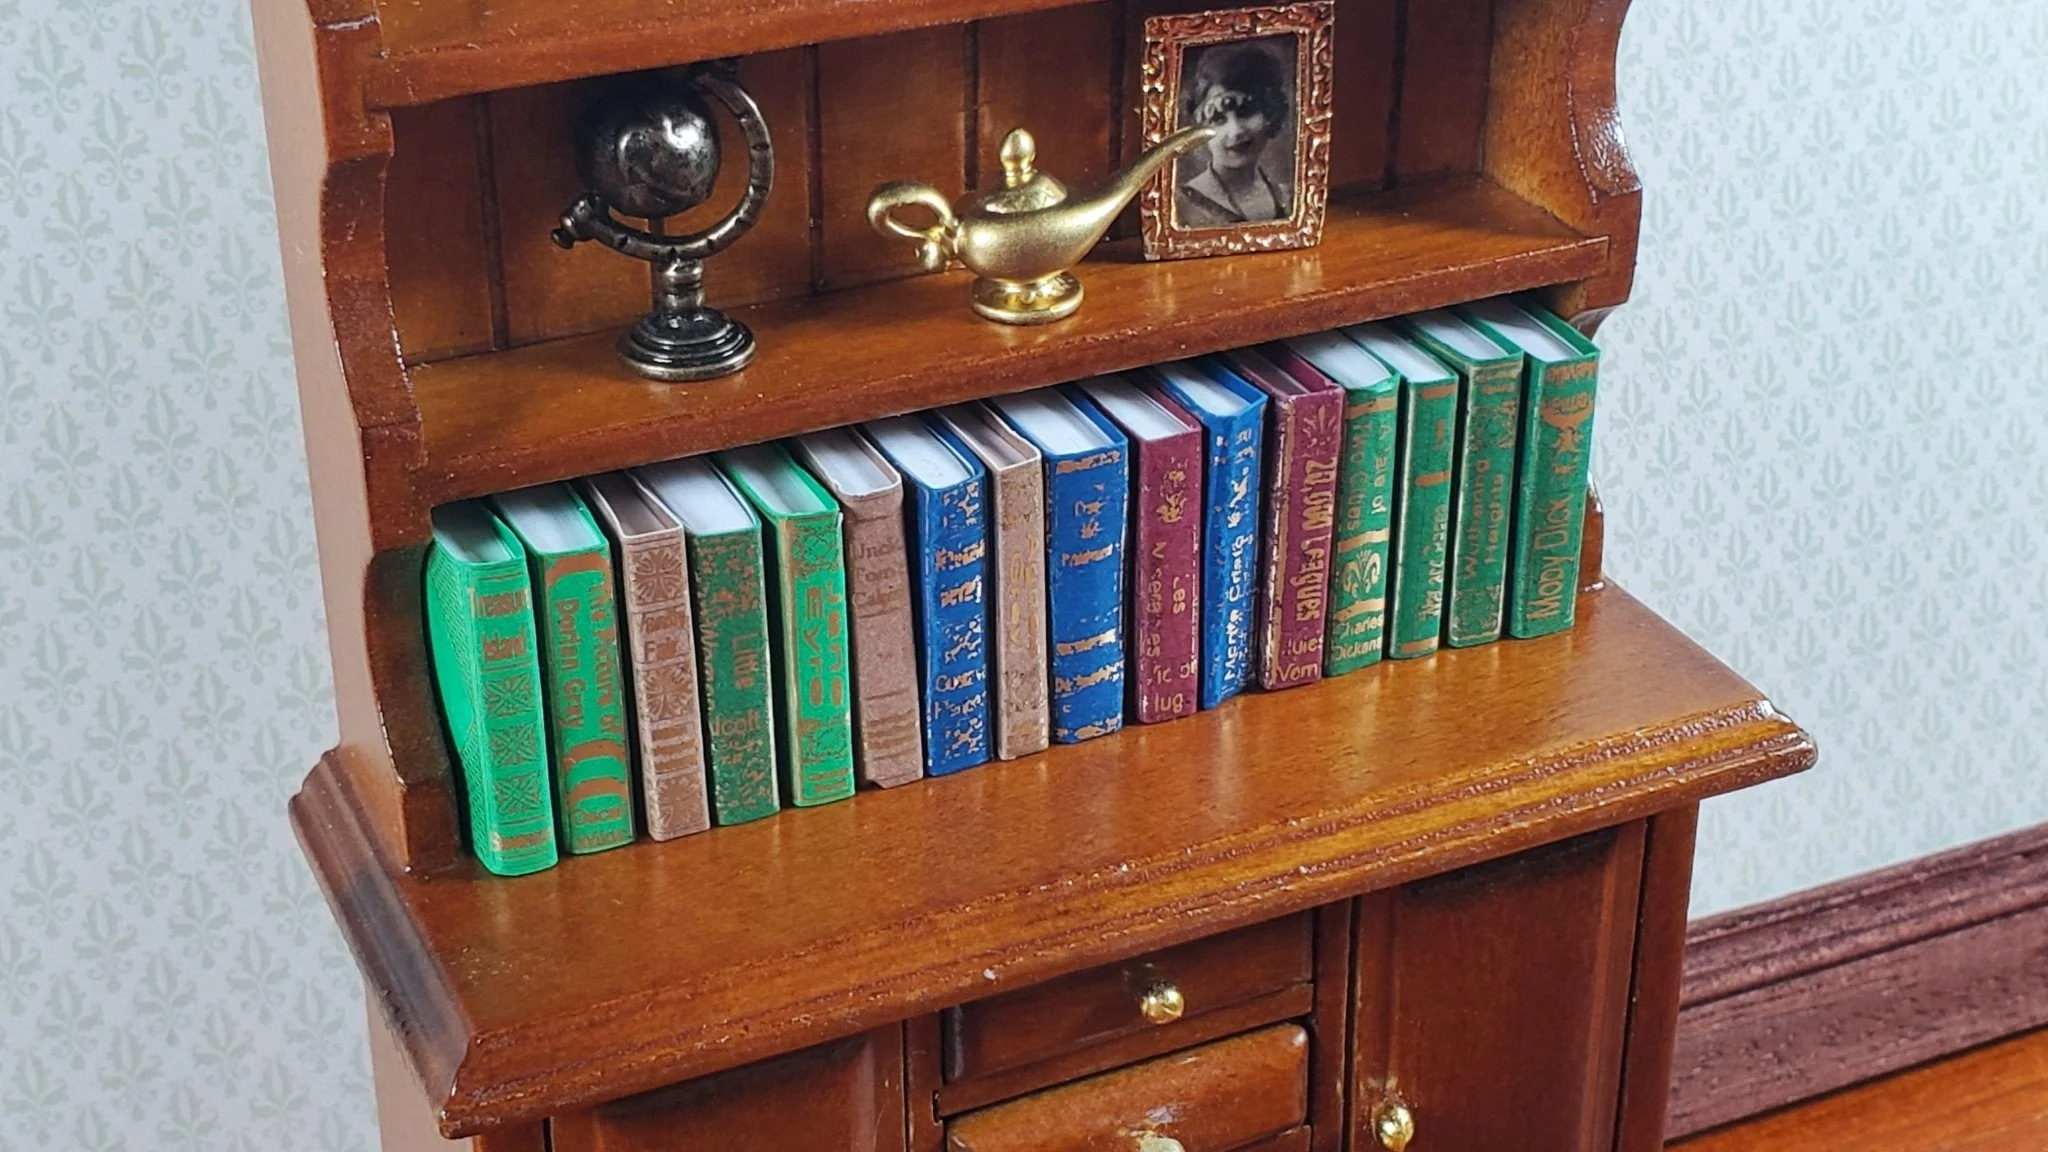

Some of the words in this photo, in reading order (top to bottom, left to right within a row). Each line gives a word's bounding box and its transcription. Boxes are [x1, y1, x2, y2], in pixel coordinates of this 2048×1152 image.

[1371, 494, 1388, 515] of
[1290, 534, 1332, 622] Leagues
[1527, 555, 1576, 620] Moby
[557, 599, 582, 672] Dorian
[733, 632, 760, 690] Little
[804, 586, 822, 707] Eyre
[827, 579, 843, 707] Jane
[560, 678, 587, 729] Gray
